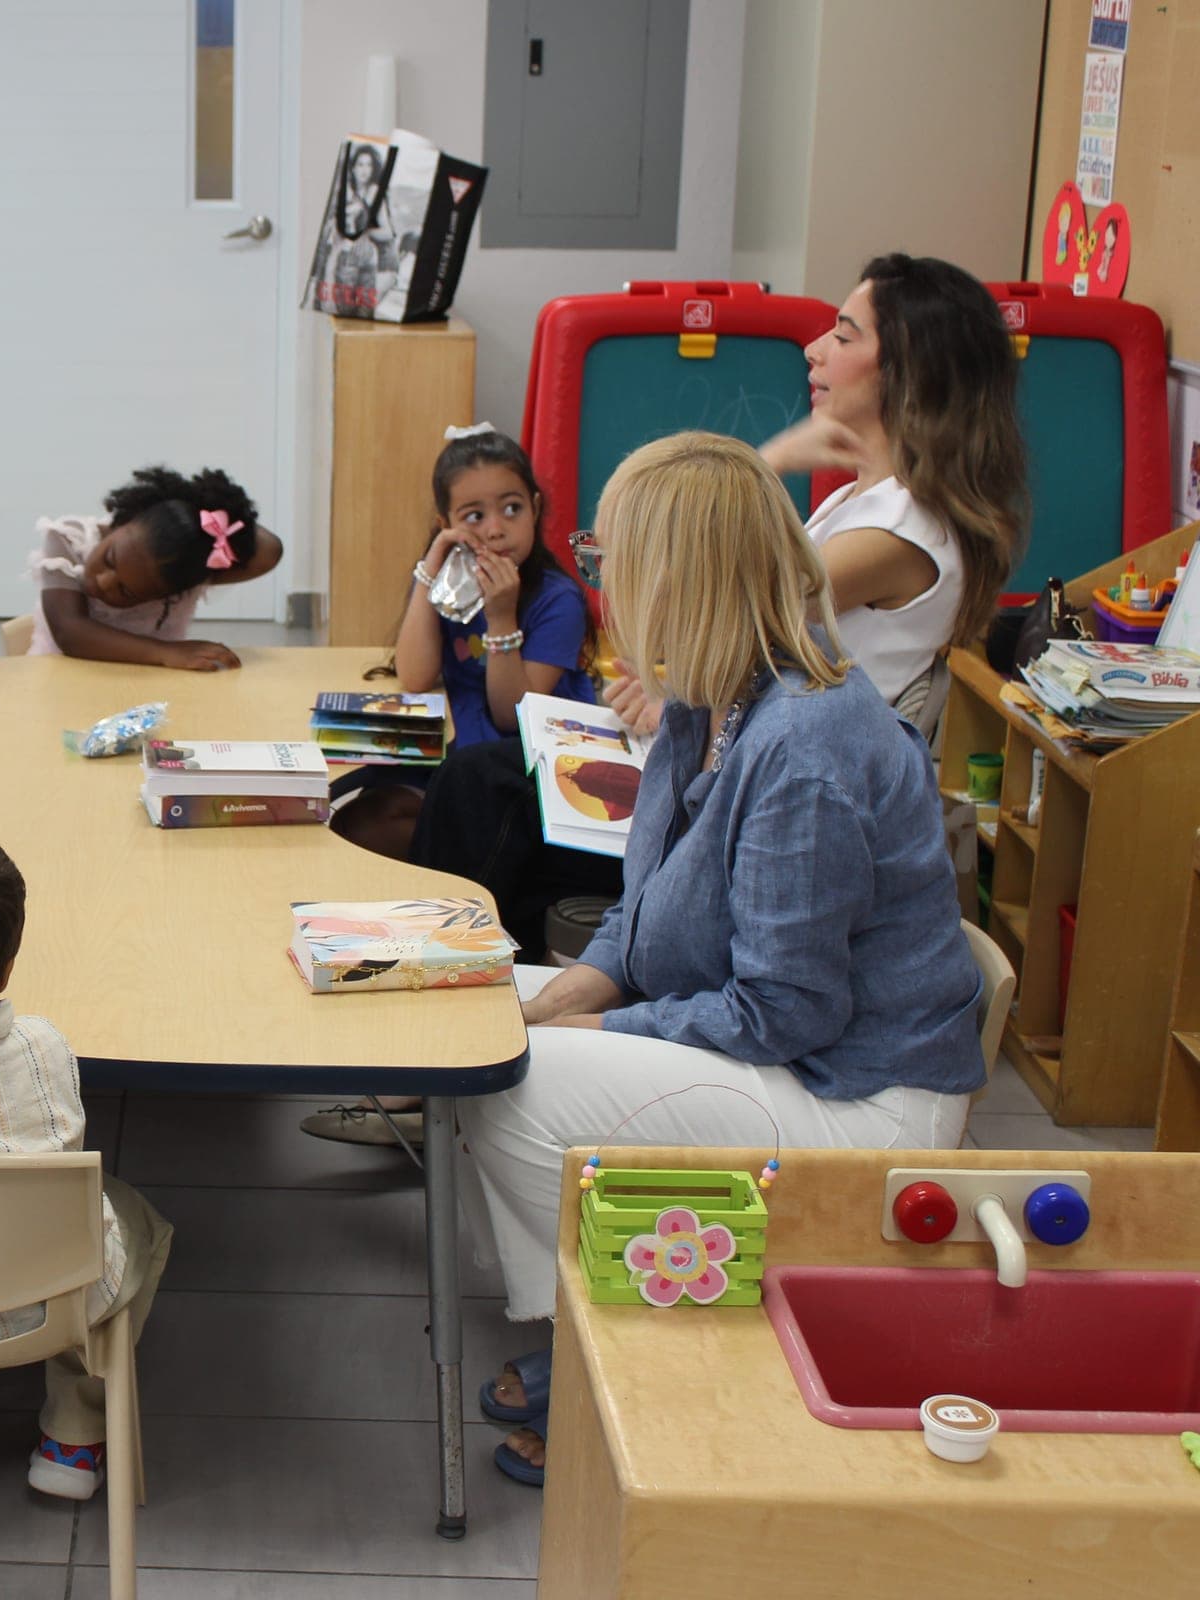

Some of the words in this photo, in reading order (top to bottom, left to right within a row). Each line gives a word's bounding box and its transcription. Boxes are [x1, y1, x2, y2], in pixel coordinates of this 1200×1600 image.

[1086, 64, 1119, 93] JESUS
[1079, 155, 1111, 175] children
[317, 281, 378, 309] GUESS
[1152, 672, 1189, 688] Biblia
